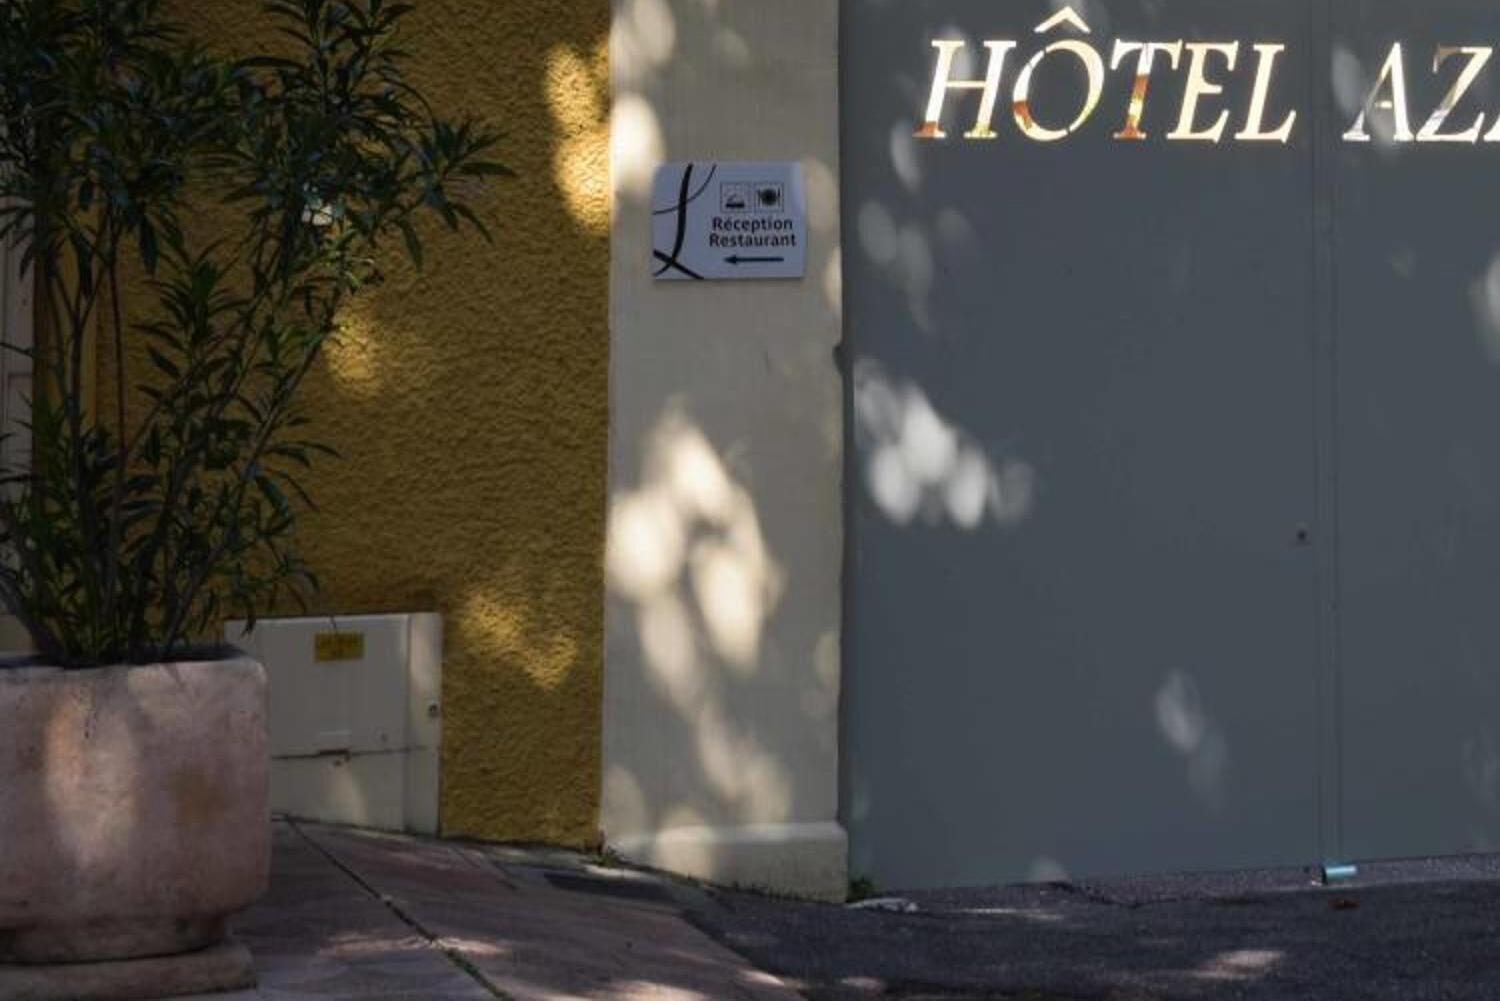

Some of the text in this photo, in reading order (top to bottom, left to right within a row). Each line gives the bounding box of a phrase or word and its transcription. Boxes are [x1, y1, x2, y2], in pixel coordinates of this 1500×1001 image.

[913, 6, 1298, 142] HÔTEL
[713, 217, 793, 233] Réception
[709, 233, 797, 248] Restaurant
